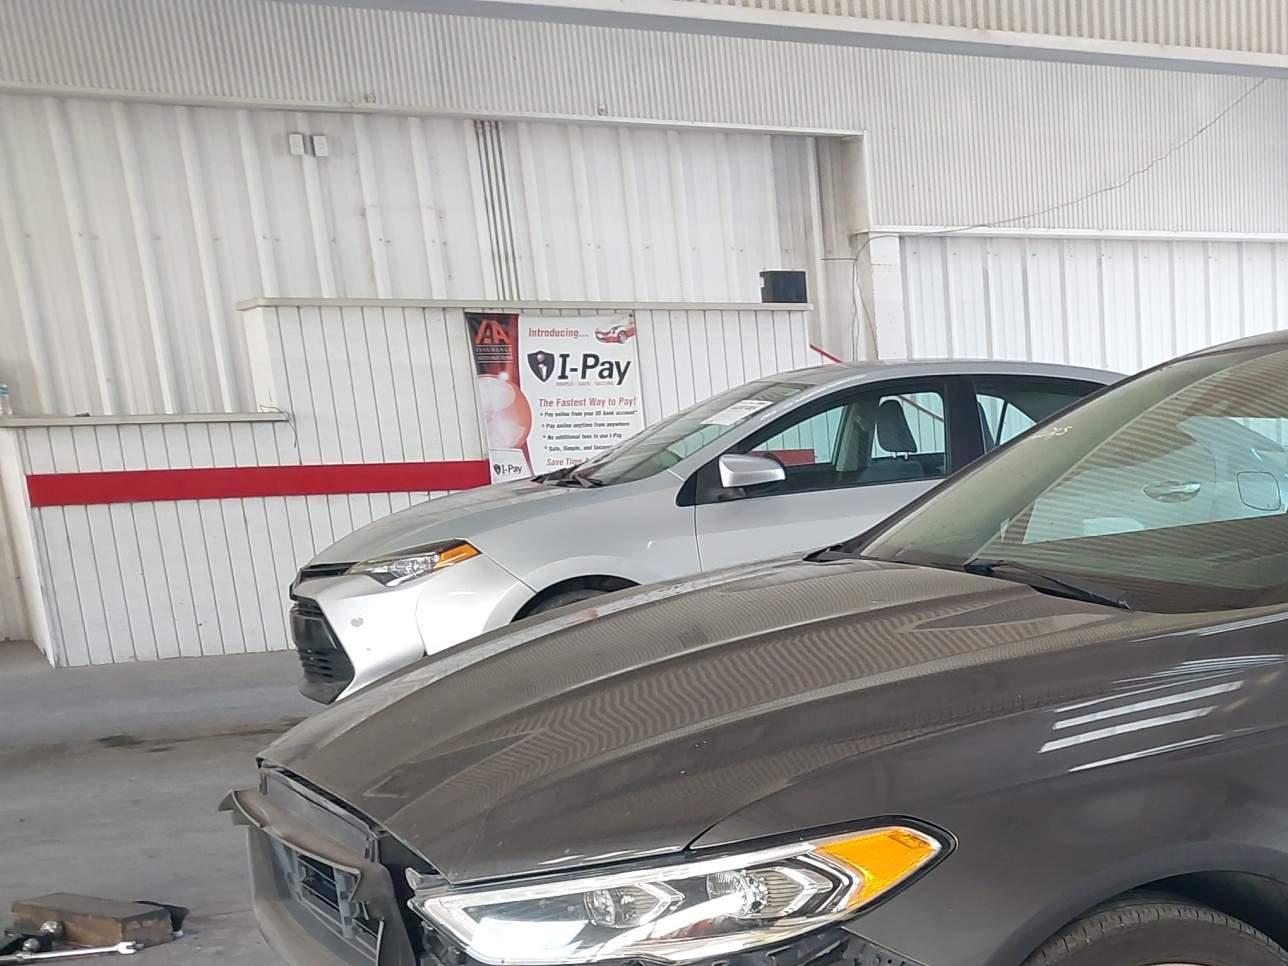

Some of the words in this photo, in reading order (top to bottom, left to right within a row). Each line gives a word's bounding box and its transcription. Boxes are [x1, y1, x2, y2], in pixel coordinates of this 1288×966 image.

[558, 353, 632, 385] I-Pay
[539, 398, 554, 407] The
[556, 398, 586, 407] Fastest
[589, 397, 606, 408] Way
[608, 397, 616, 406] to
[618, 396, 637, 407] Pay!
[546, 458, 564, 466] Save
[501, 464, 522, 475] I-Pay
